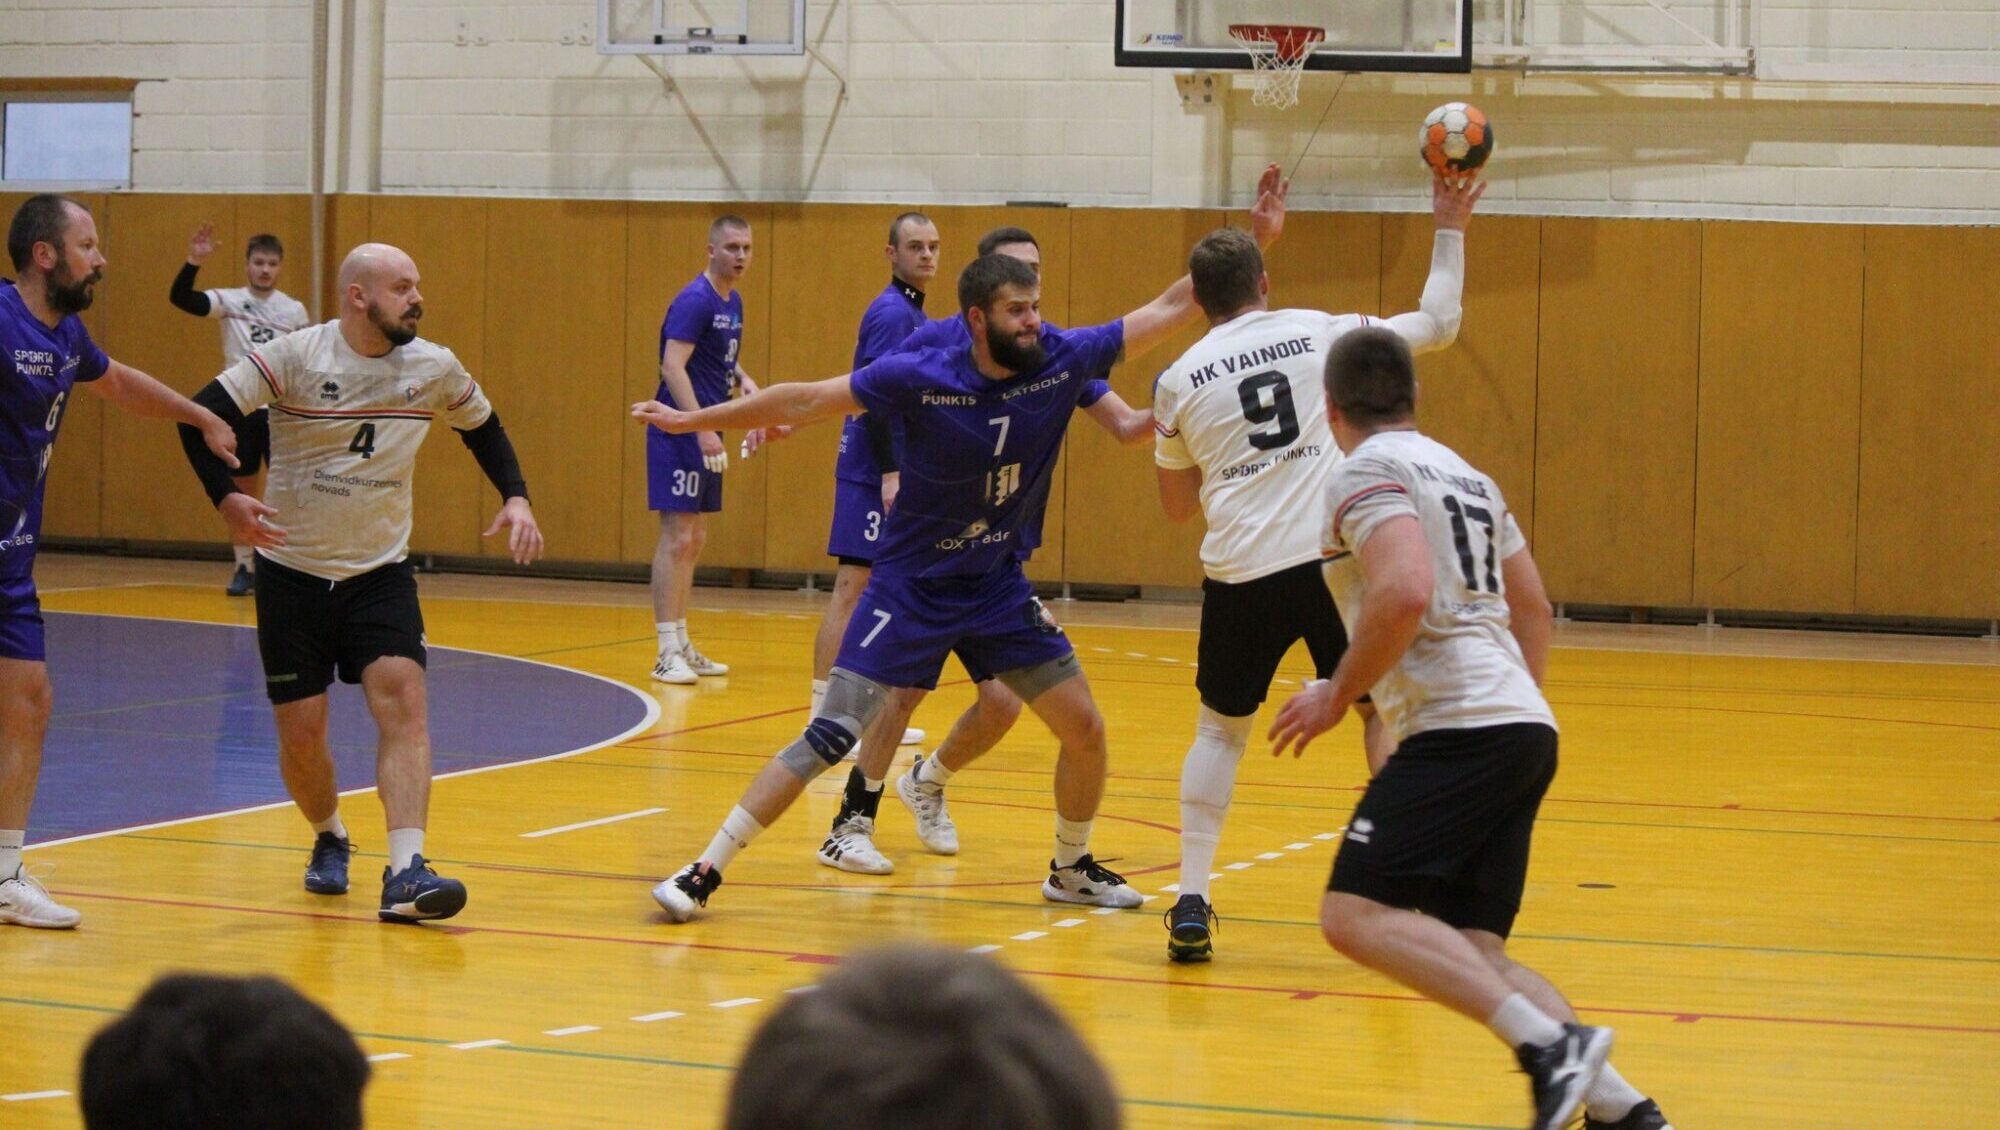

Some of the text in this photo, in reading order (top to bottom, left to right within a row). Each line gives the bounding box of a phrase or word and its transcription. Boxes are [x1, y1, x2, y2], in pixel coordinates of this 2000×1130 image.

[250, 324, 274, 343] 23
[1190, 362, 1220, 390] HK
[45, 391, 64, 432] 6
[921, 395, 977, 406] PUNKTS
[1237, 369, 1300, 451] 9
[349, 422, 376, 459] 4
[988, 415, 1010, 457] 7
[311, 482, 351, 497] novads
[671, 468, 700, 497] 30
[864, 510, 881, 542] 3
[1442, 495, 1499, 593] 17
[859, 608, 892, 648] 7
